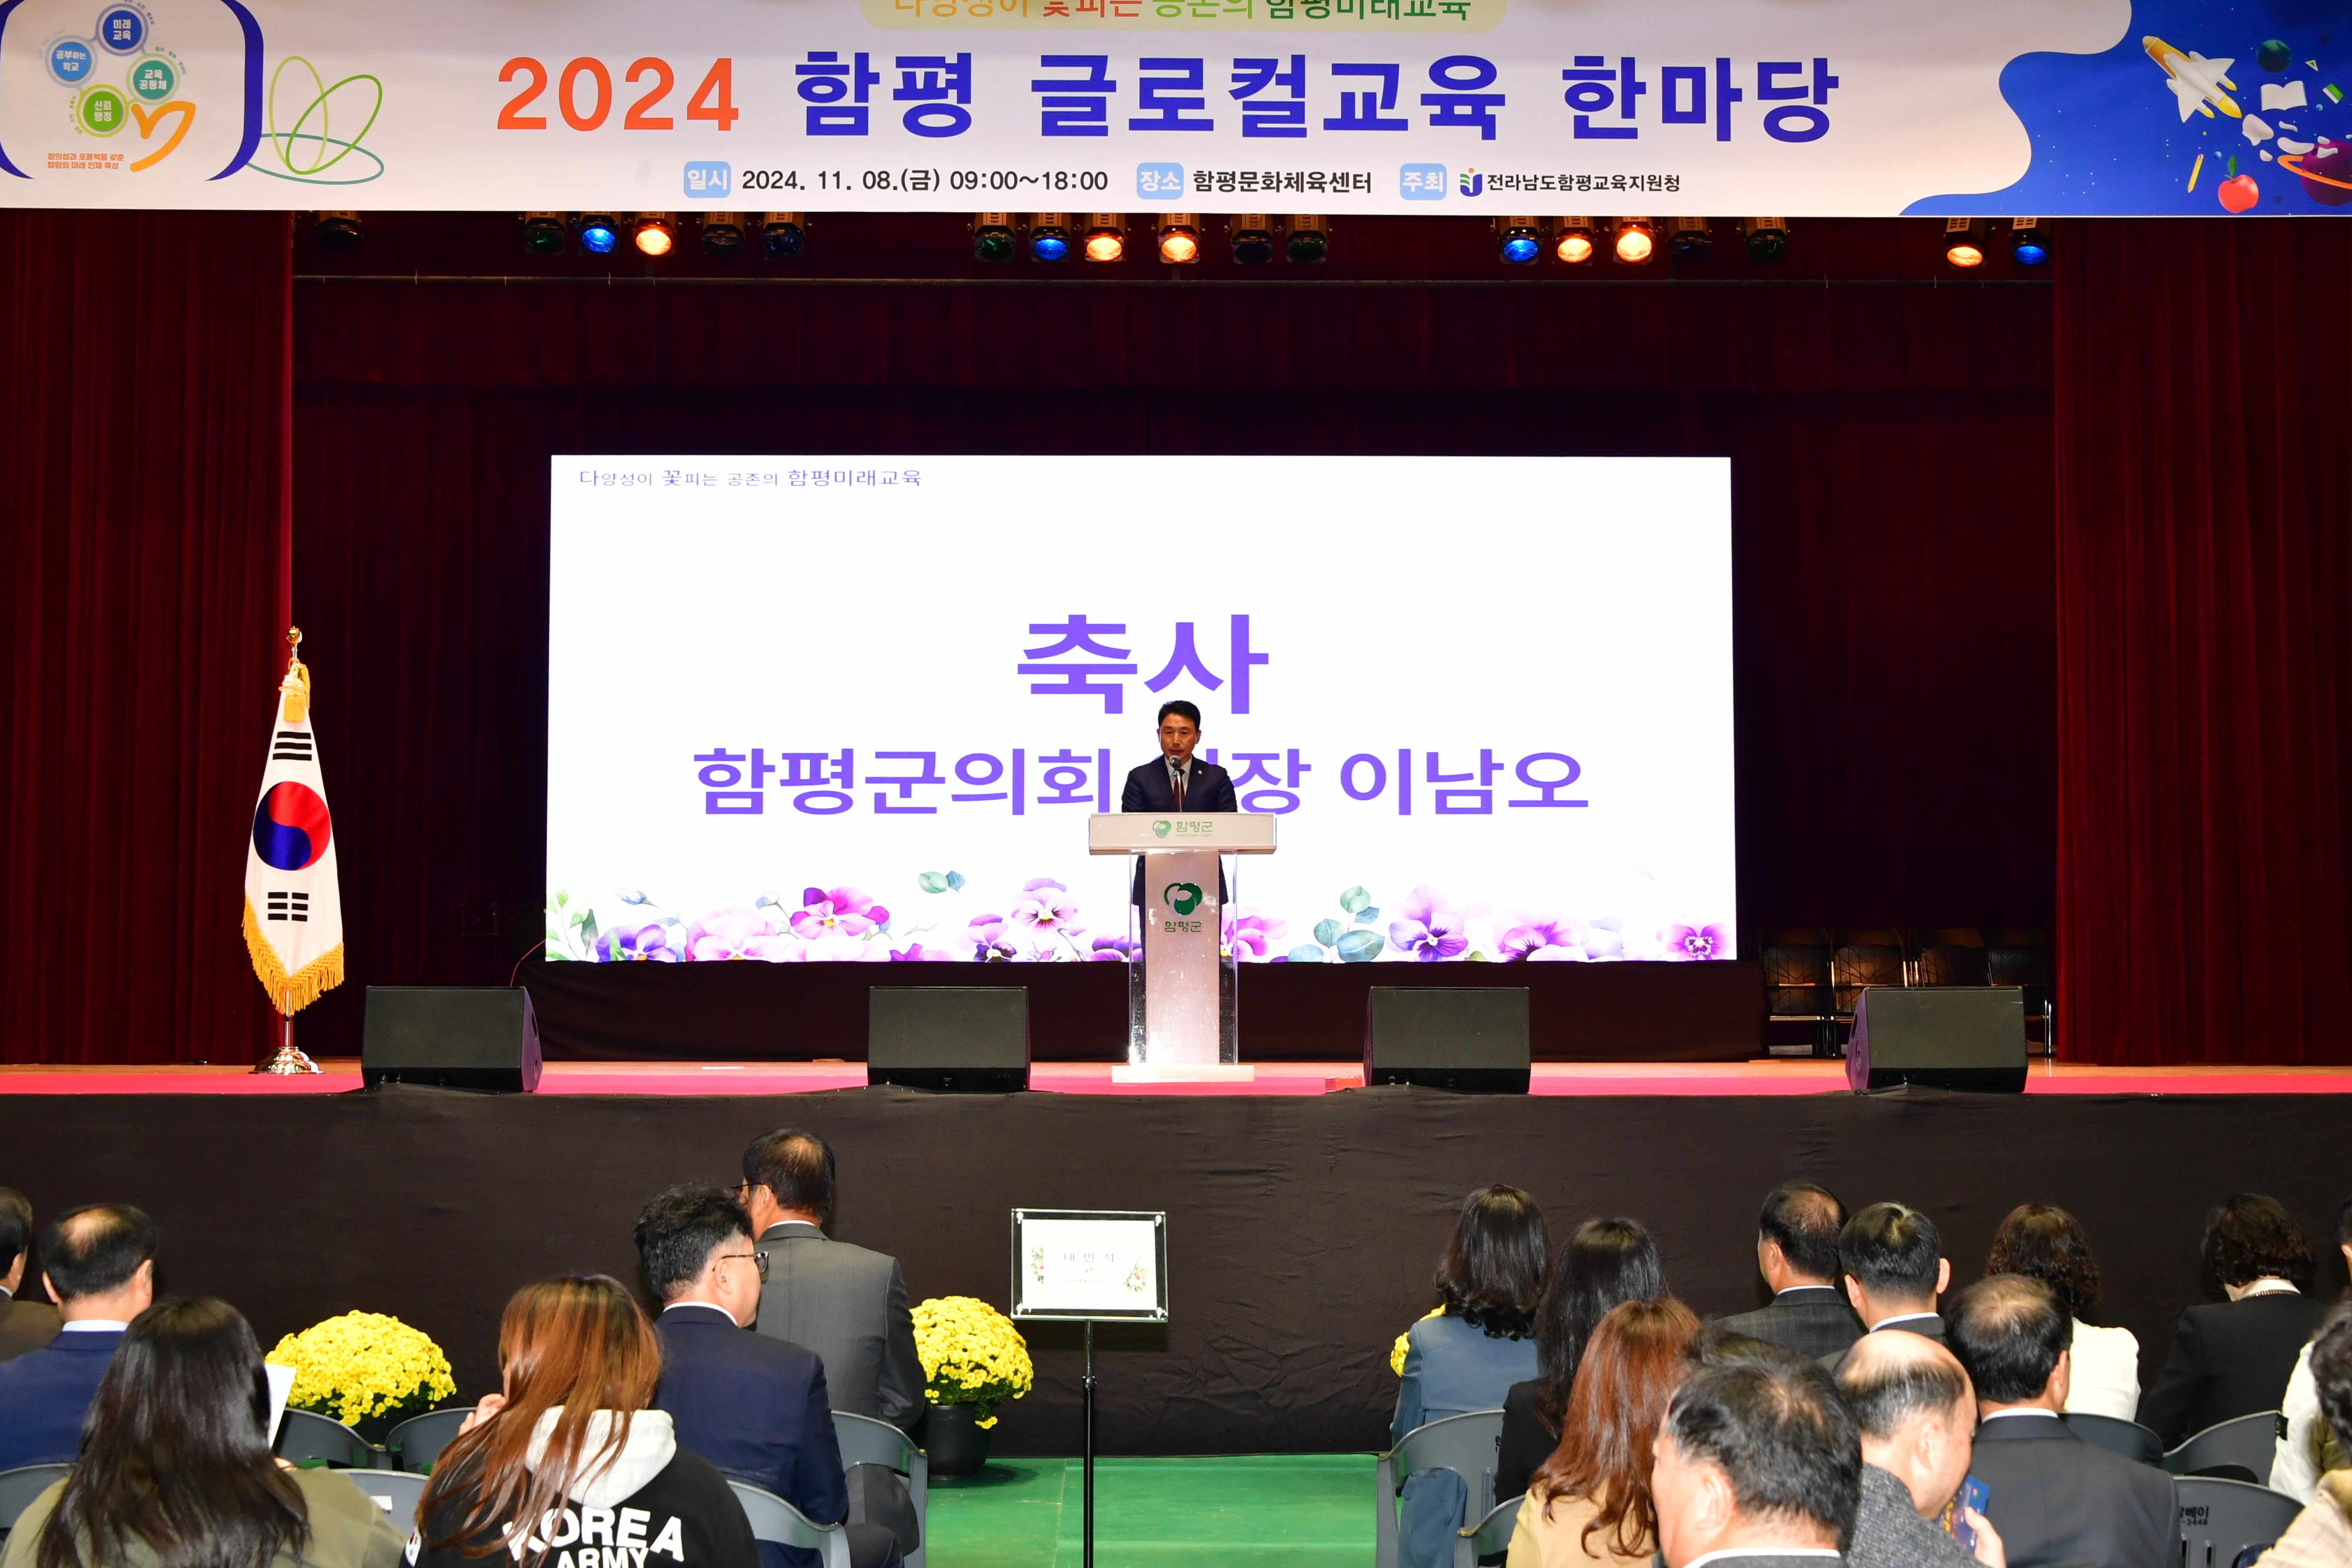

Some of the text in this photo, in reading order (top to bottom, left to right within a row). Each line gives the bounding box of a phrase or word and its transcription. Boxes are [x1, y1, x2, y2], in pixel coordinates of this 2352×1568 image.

[113, 19, 131, 30] 미래
[113, 30, 131, 40] 교육
[56, 50, 87, 60] 공부하는
[63, 62, 79, 72] 학교
[144, 69, 163, 80] 교육
[139, 80, 167, 90] 공동체
[94, 100, 112, 111] 신뢰
[497, 51, 1839, 143] 2024 함평 글로컬교육 한마당
[94, 111, 112, 122] 행정
[688, 169, 727, 190] 일시
[742, 168, 1108, 192] 2024. 11. 08.(금) 09:00~18:00
[1140, 170, 1181, 192] 장소
[1193, 170, 1371, 193] 함평문화체육센터
[1403, 171, 1443, 192] 주최
[1487, 174, 1680, 193] 전라남도함평교육지원청
[580, 470, 922, 487] 다양성이 꽃피는 공존의 함평미래교육
[1017, 614, 1269, 714] 축사
[693, 747, 1111, 816] 함평군의회
[1339, 748, 1589, 816] 이남오
[1176, 821, 1213, 833] 함평군
[1164, 921, 1202, 933] 함평군
[502, 1505, 684, 1562] KOREA
[556, 1546, 649, 1568] ARMY
